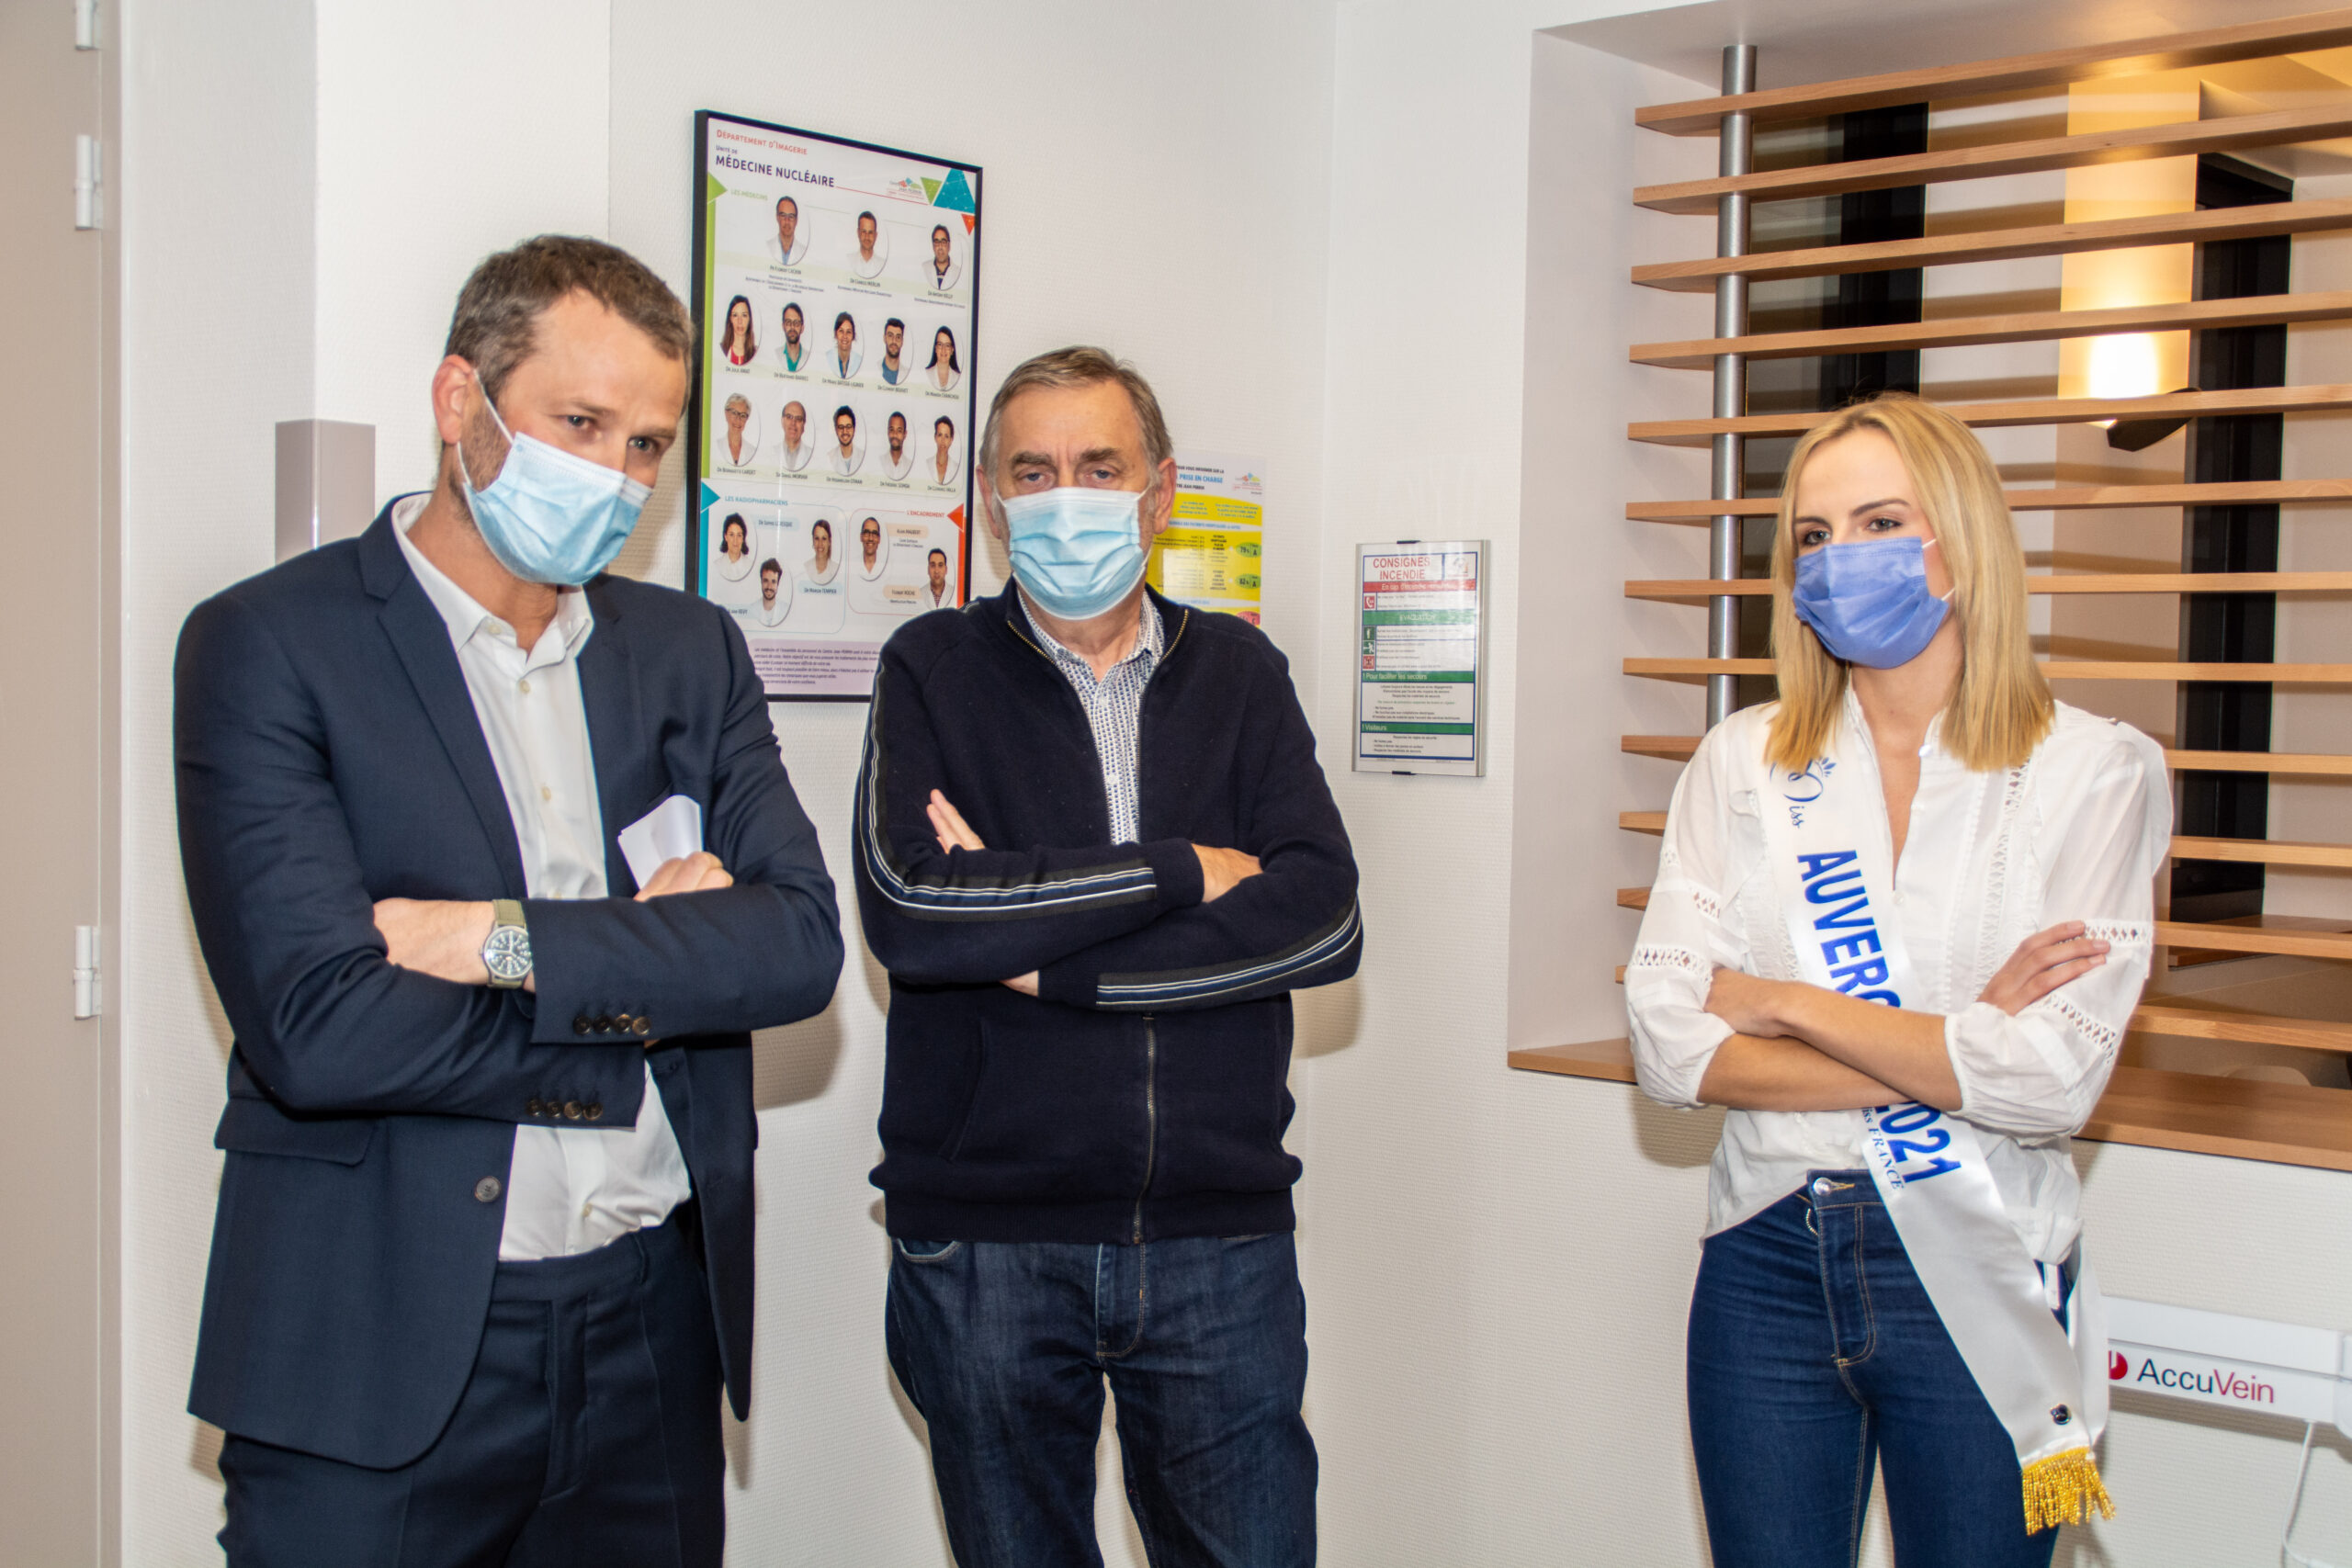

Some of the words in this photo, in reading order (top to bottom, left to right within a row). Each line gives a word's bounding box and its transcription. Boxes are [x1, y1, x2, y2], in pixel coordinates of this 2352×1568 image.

[716, 154, 773, 175] MÉDECINE
[775, 167, 834, 187] NUCLÉAIRE
[1373, 557, 1430, 569] CONSIGNES
[1379, 570, 1426, 581] INCENDIE
[1796, 850, 1901, 1008] AUVER
[1868, 1128, 1904, 1190] FRANCE
[2136, 1358, 2274, 1404] AccuVein
